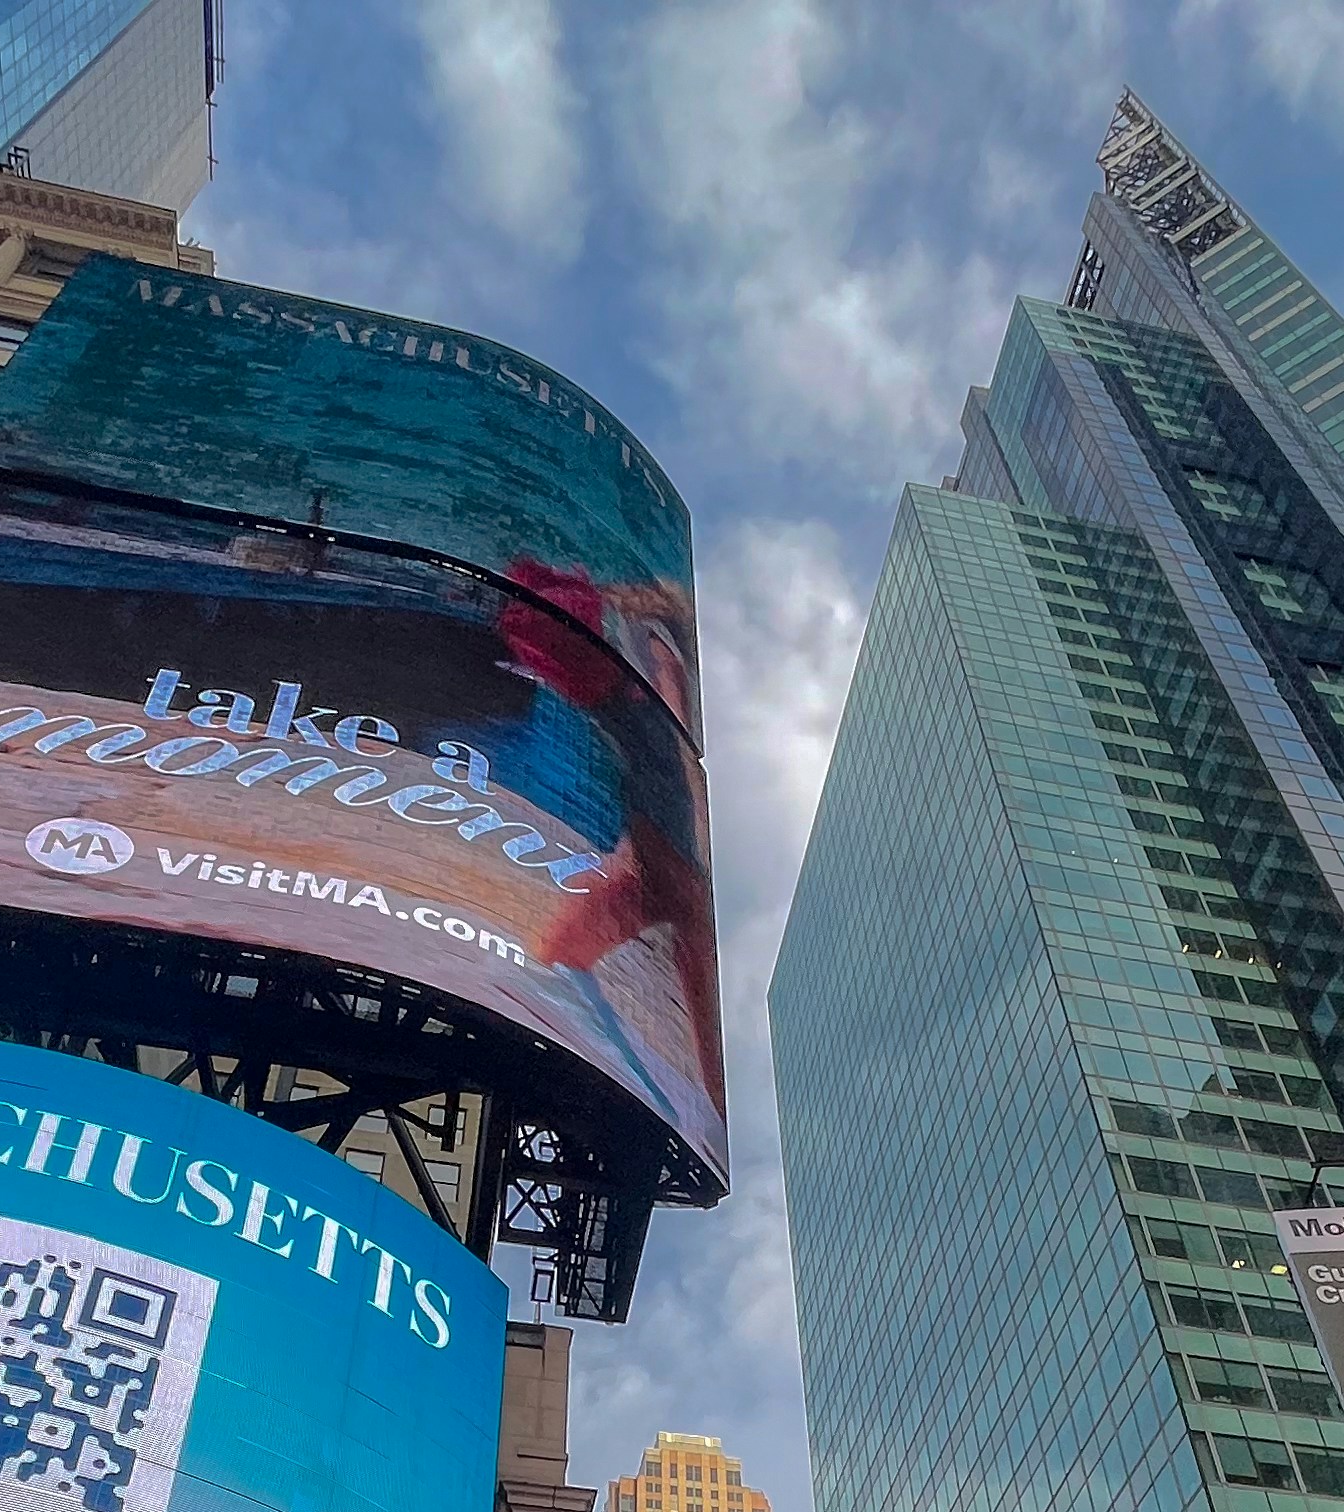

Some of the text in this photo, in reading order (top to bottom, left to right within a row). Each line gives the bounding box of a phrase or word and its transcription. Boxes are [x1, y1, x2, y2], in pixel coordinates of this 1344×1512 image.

[142, 667, 497, 797] take a
[42, 827, 120, 862] MA
[156, 847, 528, 968] VisitMA.com
